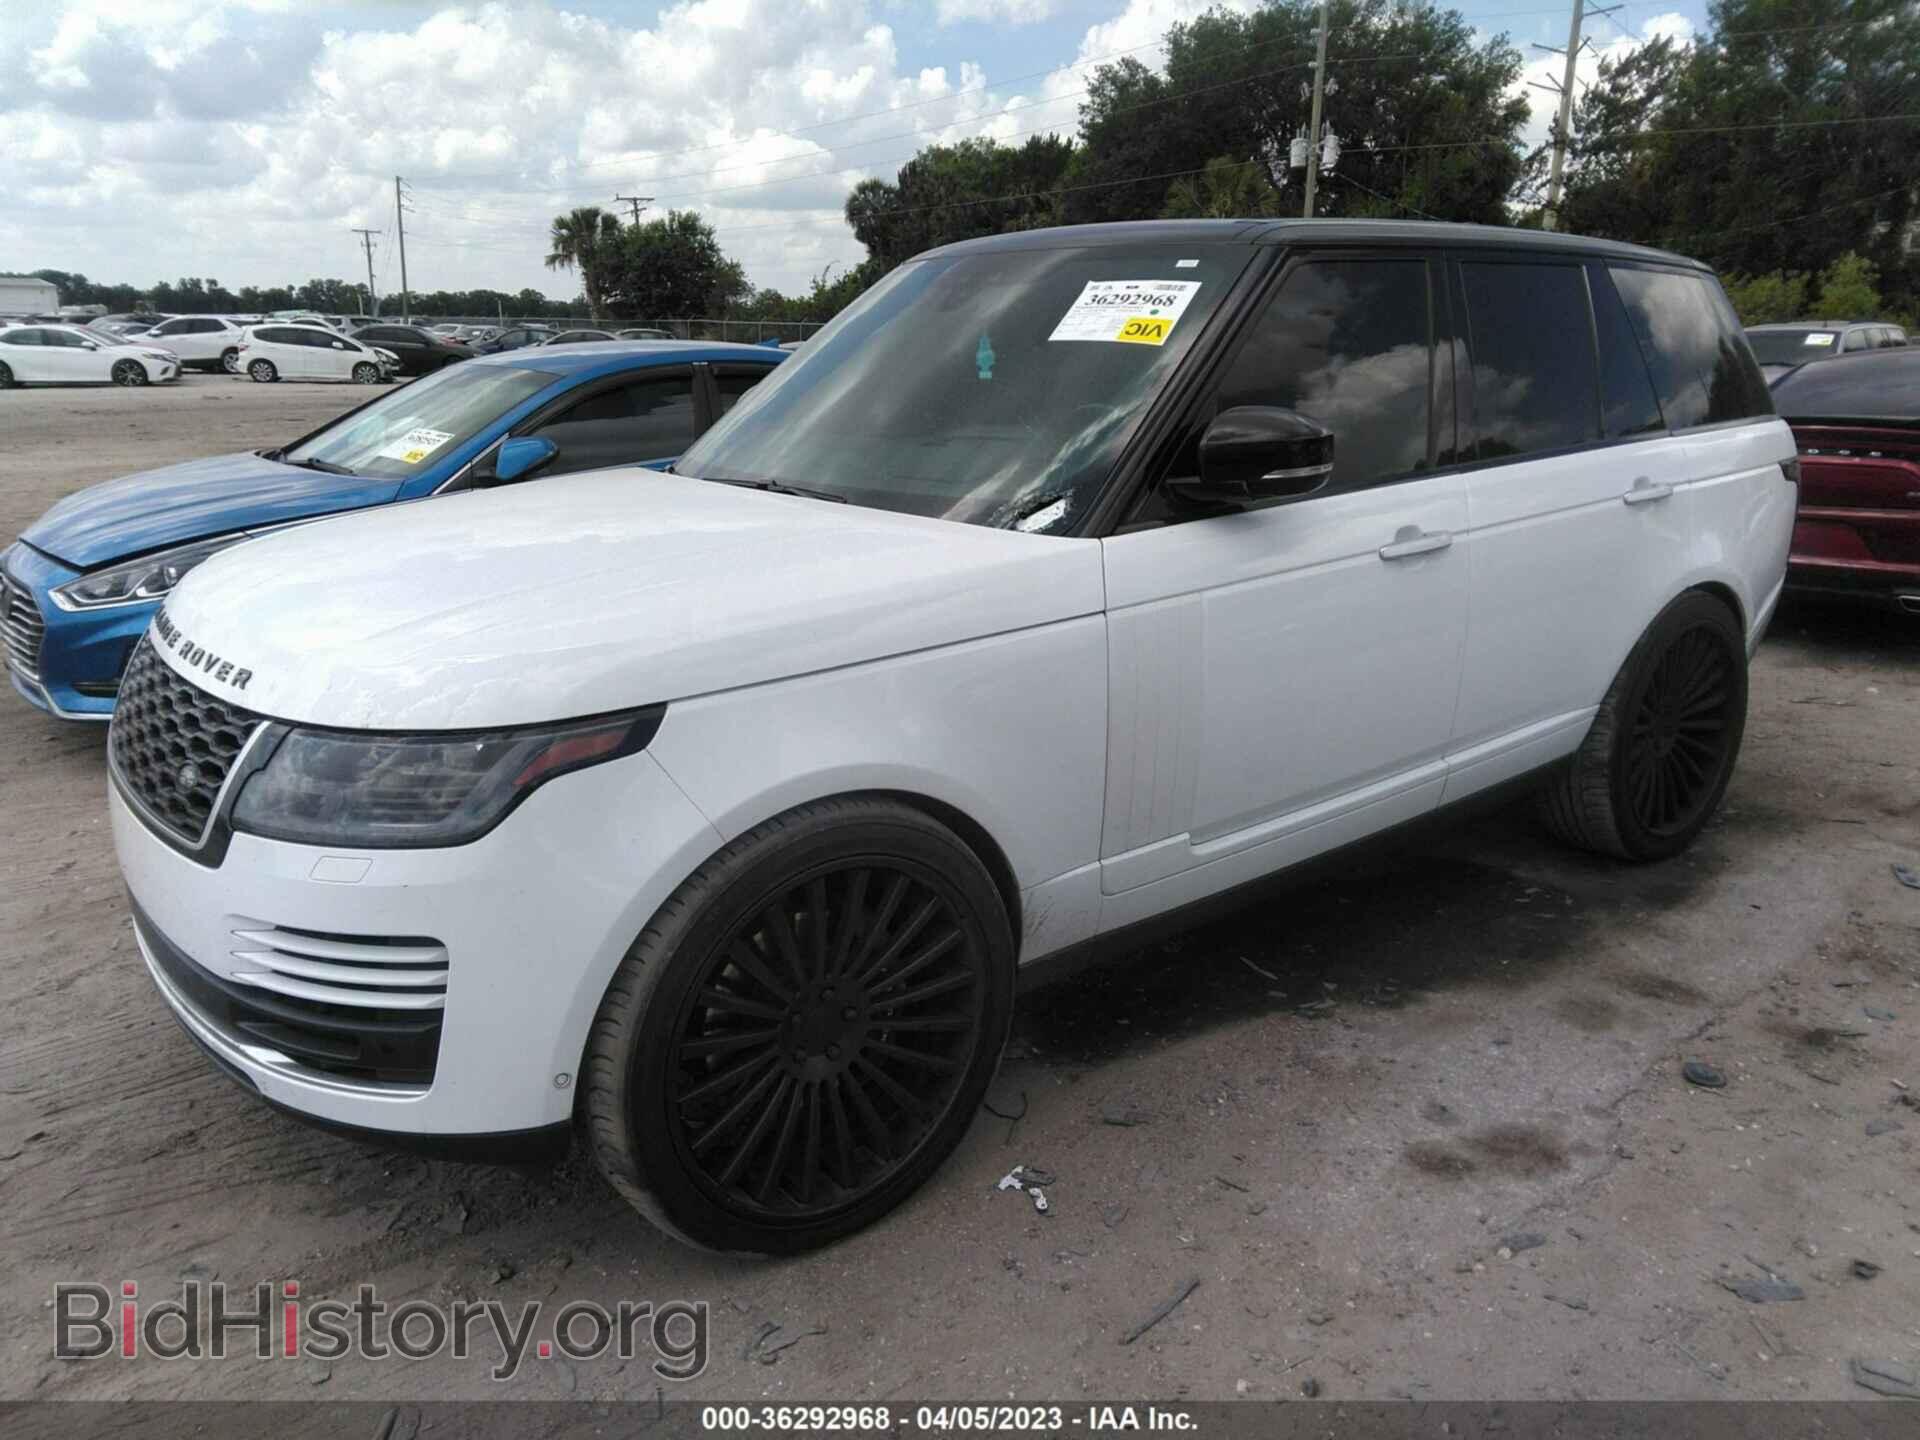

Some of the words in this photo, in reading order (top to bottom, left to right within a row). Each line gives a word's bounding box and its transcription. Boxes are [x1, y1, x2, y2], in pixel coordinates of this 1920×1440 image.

[1085, 293, 1177, 306] 36292968
[1125, 323, 1162, 337] VIC
[178, 640, 252, 690] ROVER
